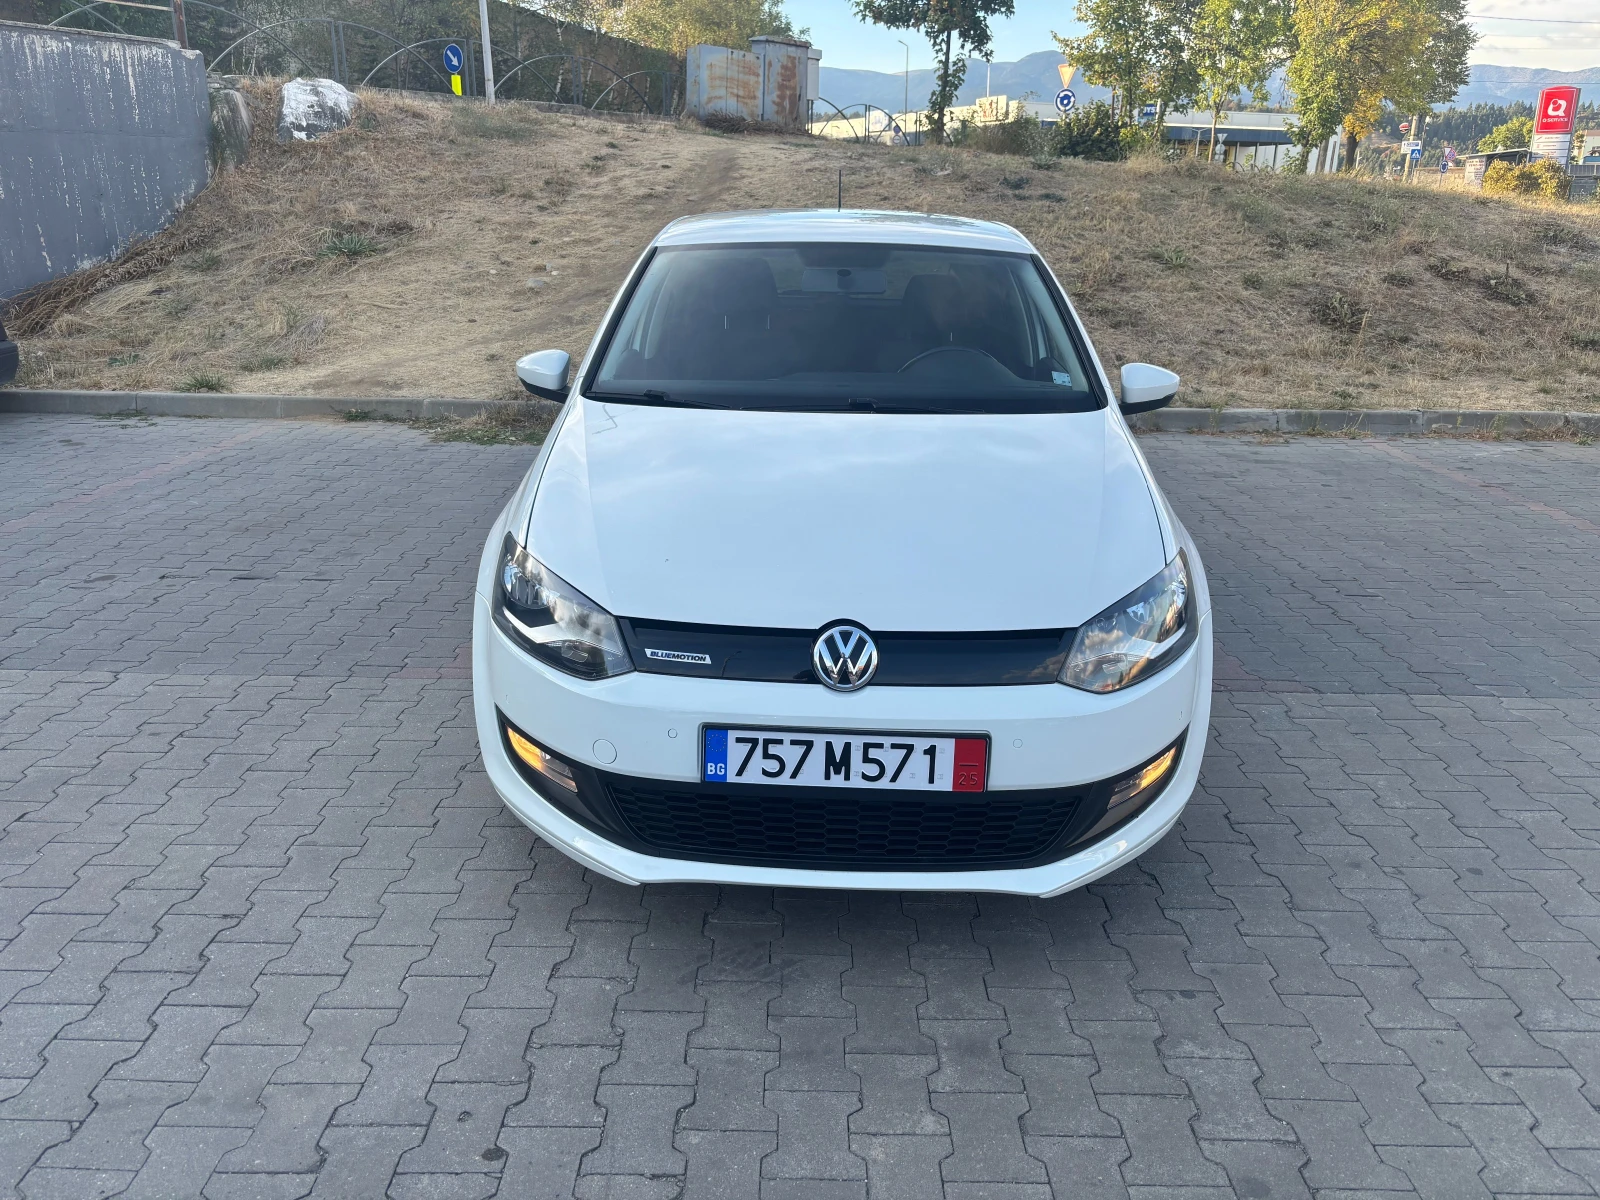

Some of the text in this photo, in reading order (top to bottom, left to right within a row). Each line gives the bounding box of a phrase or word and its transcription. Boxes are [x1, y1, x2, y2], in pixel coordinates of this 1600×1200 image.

[650, 650, 707, 662] BLUEMOTION
[735, 736, 937, 785] 757 M 571
[707, 762, 725, 775] BG
[958, 772, 978, 785] 25
